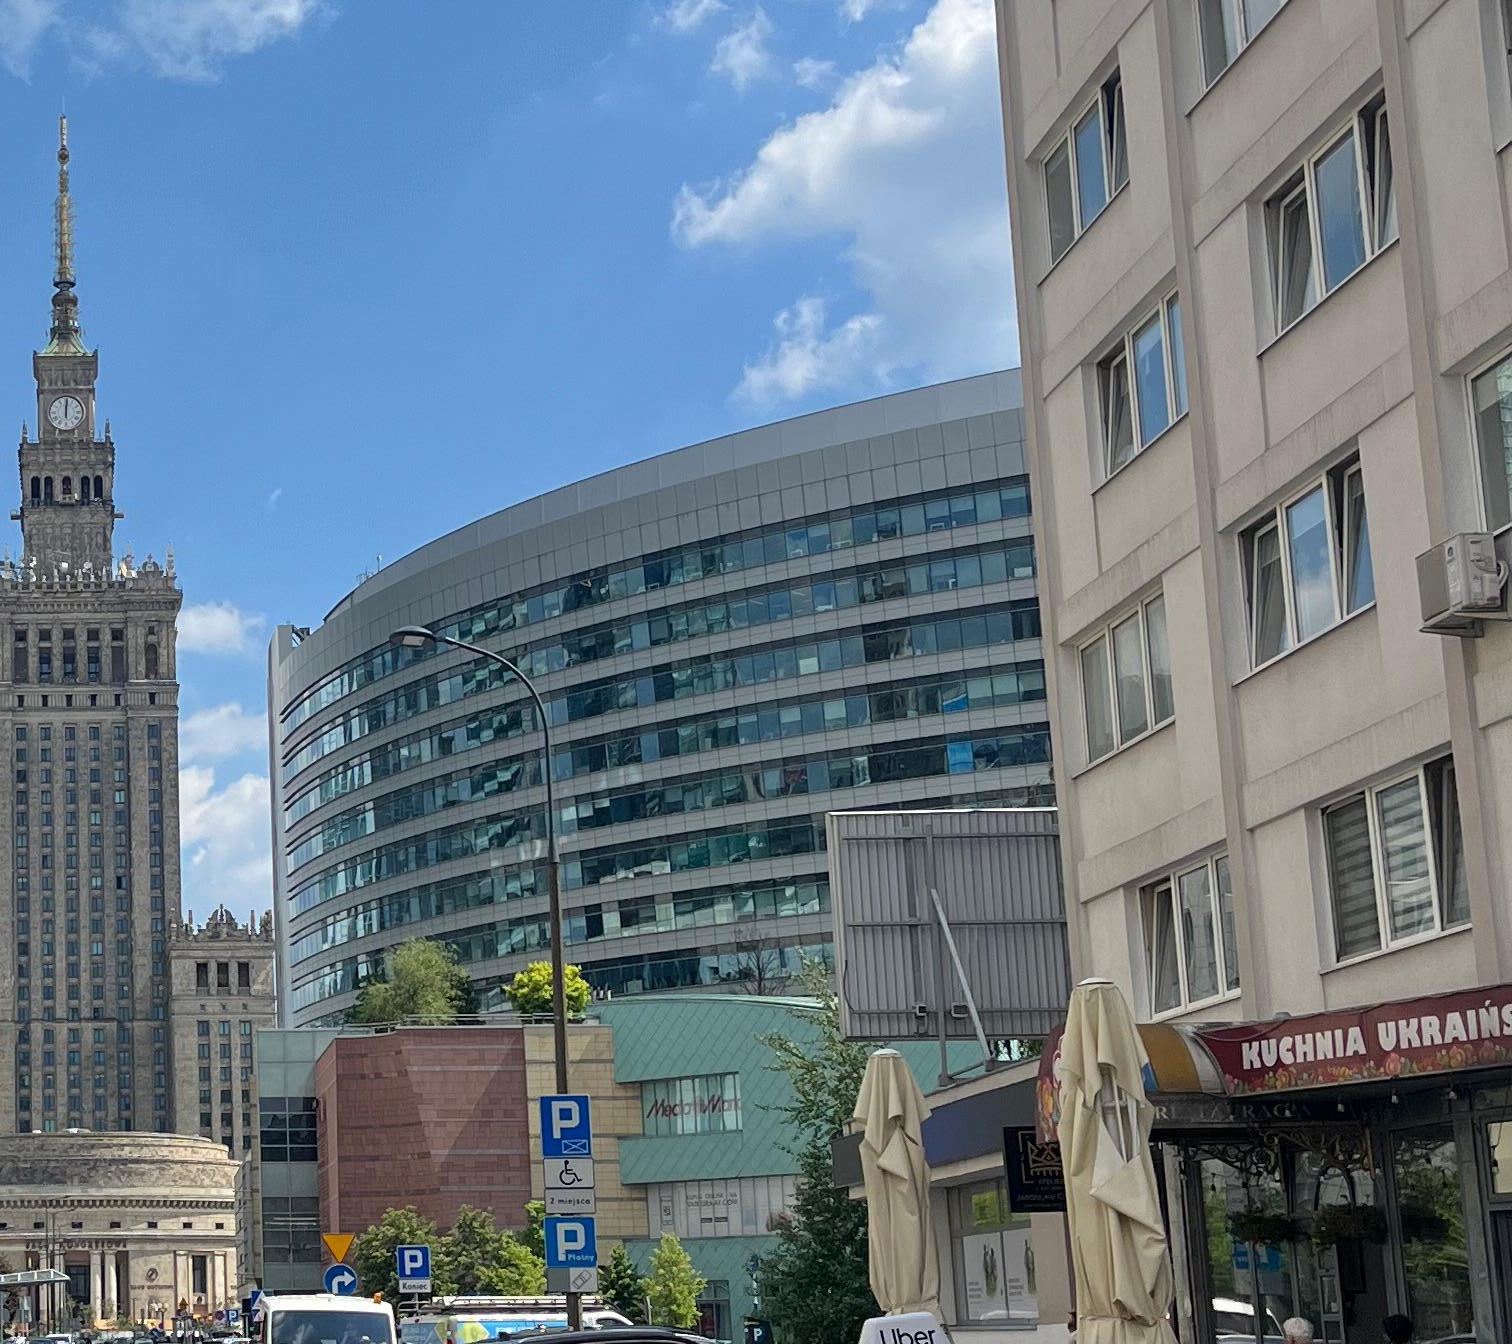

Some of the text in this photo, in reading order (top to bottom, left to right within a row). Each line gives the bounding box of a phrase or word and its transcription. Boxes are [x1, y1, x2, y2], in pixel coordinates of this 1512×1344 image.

[1241, 1026, 1368, 1071] KUCHNIA
[551, 1100, 580, 1139] P
[550, 1197, 591, 1207] 2 miejsca
[556, 1222, 586, 1262] P
[404, 1249, 423, 1275] P
[402, 1282, 427, 1290] Koniec
[228, 1311, 237, 1321] P
[753, 1327, 763, 1342] P
